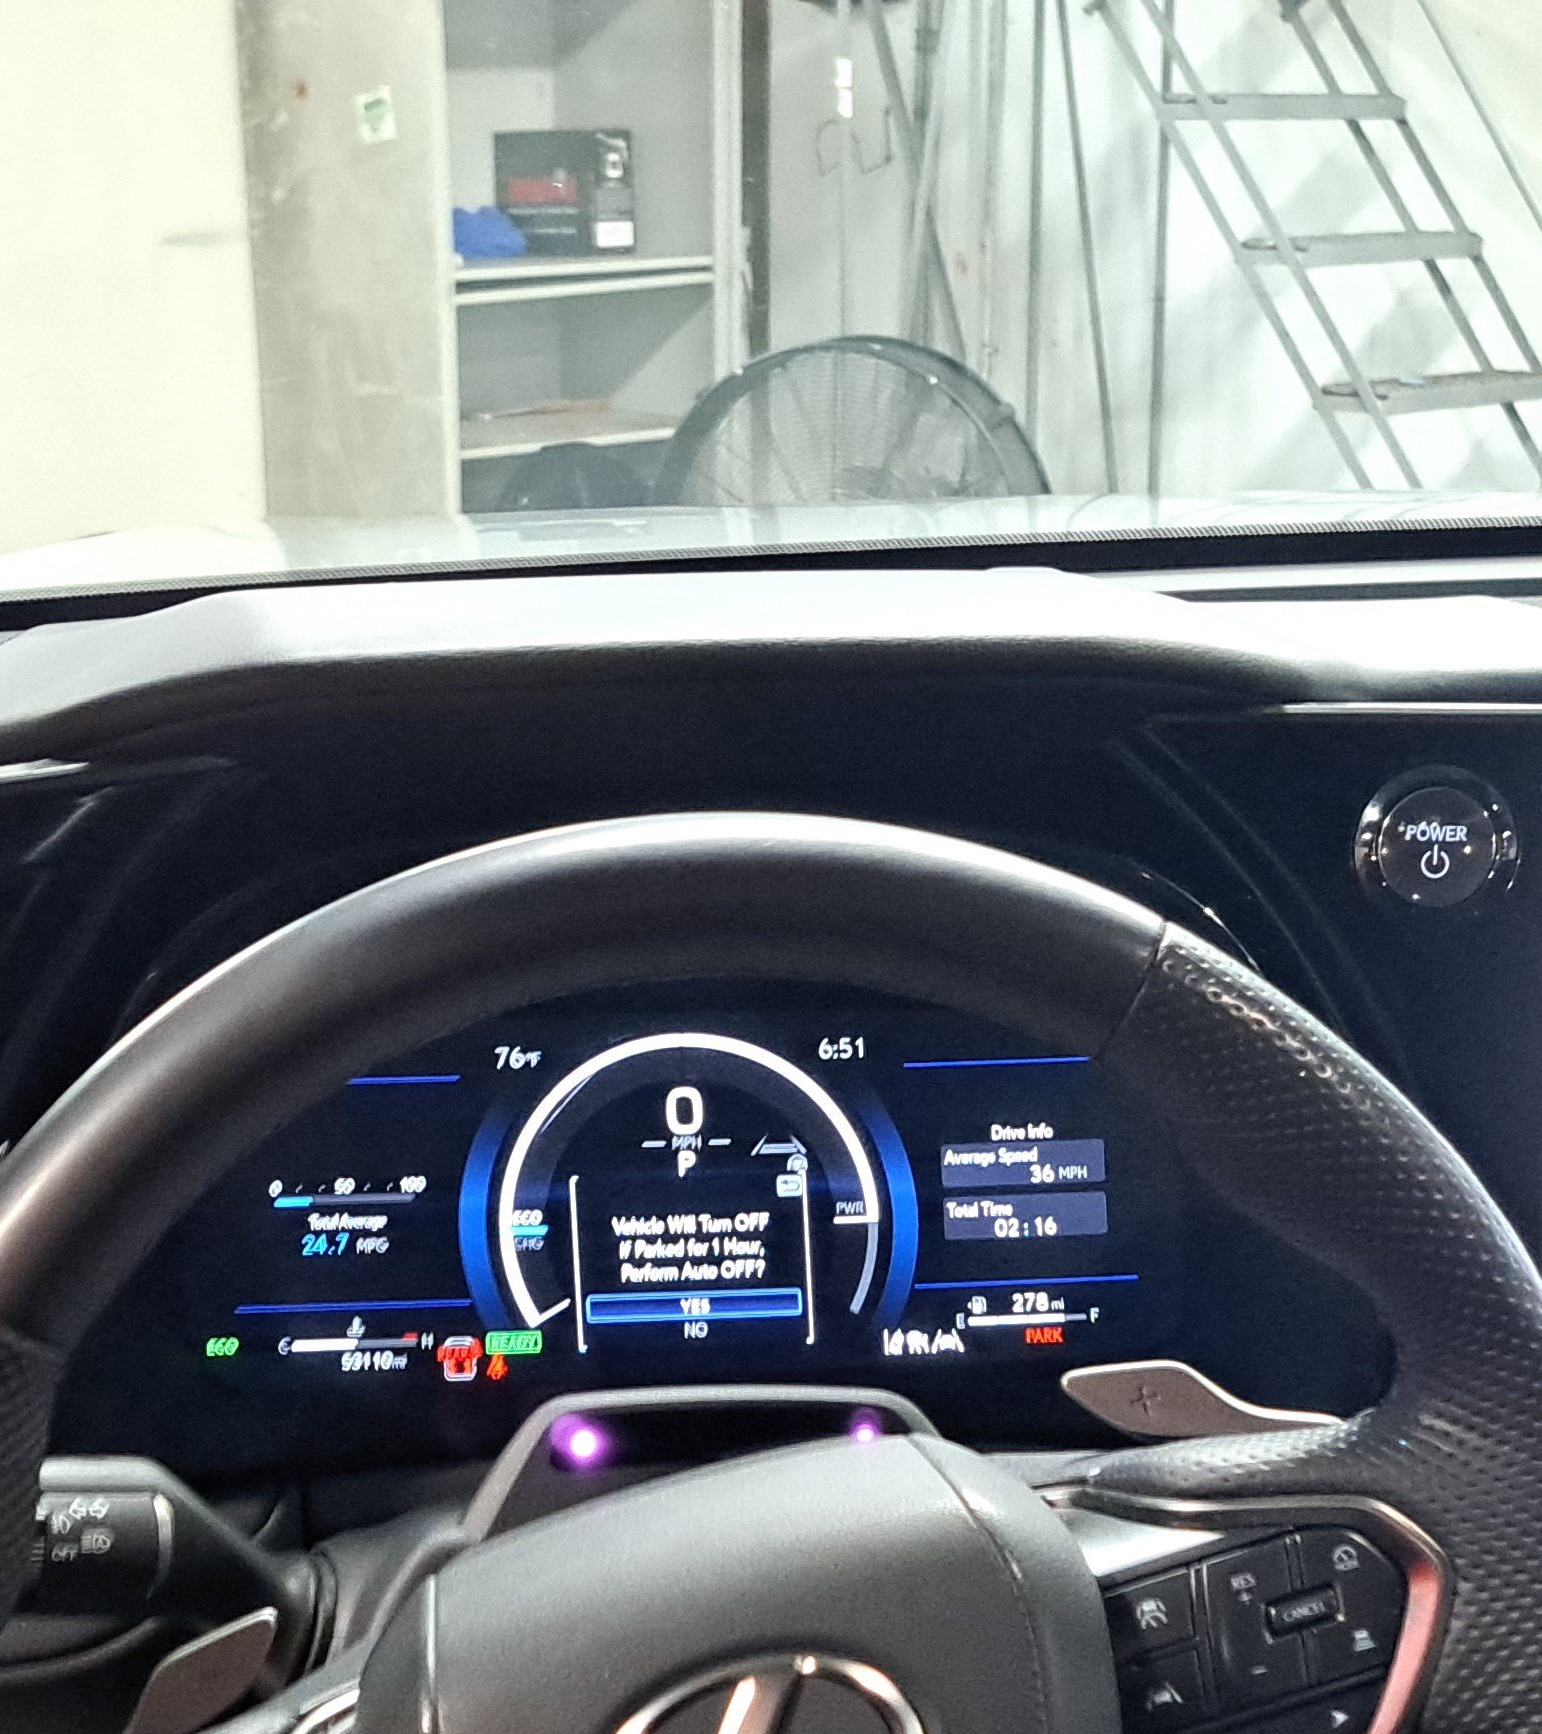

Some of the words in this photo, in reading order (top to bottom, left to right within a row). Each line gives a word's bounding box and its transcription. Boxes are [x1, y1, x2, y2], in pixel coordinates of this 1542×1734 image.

[1405, 824, 1467, 842] POWER
[818, 1037, 866, 1060] 6:51
[665, 1086, 704, 1135] 0
[991, 1125, 1025, 1141] Drive
[1028, 1123, 1053, 1139] Info
[671, 1135, 702, 1151] MPH
[677, 1150, 697, 1178] P
[944, 1150, 996, 1167] Average
[998, 1147, 1038, 1166] Speed
[1030, 1165, 1054, 1183] 36
[1059, 1165, 1088, 1179] MPH
[946, 1202, 978, 1219] Total
[981, 1201, 1013, 1217] Time
[611, 1215, 665, 1238] Vehicle
[667, 1213, 697, 1234] Will
[698, 1213, 732, 1234] Turn
[735, 1211, 770, 1232] OFF
[302, 1232, 350, 1256] 24.7
[619, 1240, 633, 1259] If
[635, 1239, 685, 1259] Parked
[687, 1239, 709, 1258] for
[711, 1239, 721, 1257] 1
[620, 1263, 680, 1283] Perform
[681, 1260, 718, 1281] Auto
[720, 1259, 766, 1279] OFF?
[680, 1298, 711, 1315] YES
[1012, 1292, 1049, 1313] 278
[684, 1323, 708, 1338] NO
[1025, 1327, 1064, 1343] PARK
